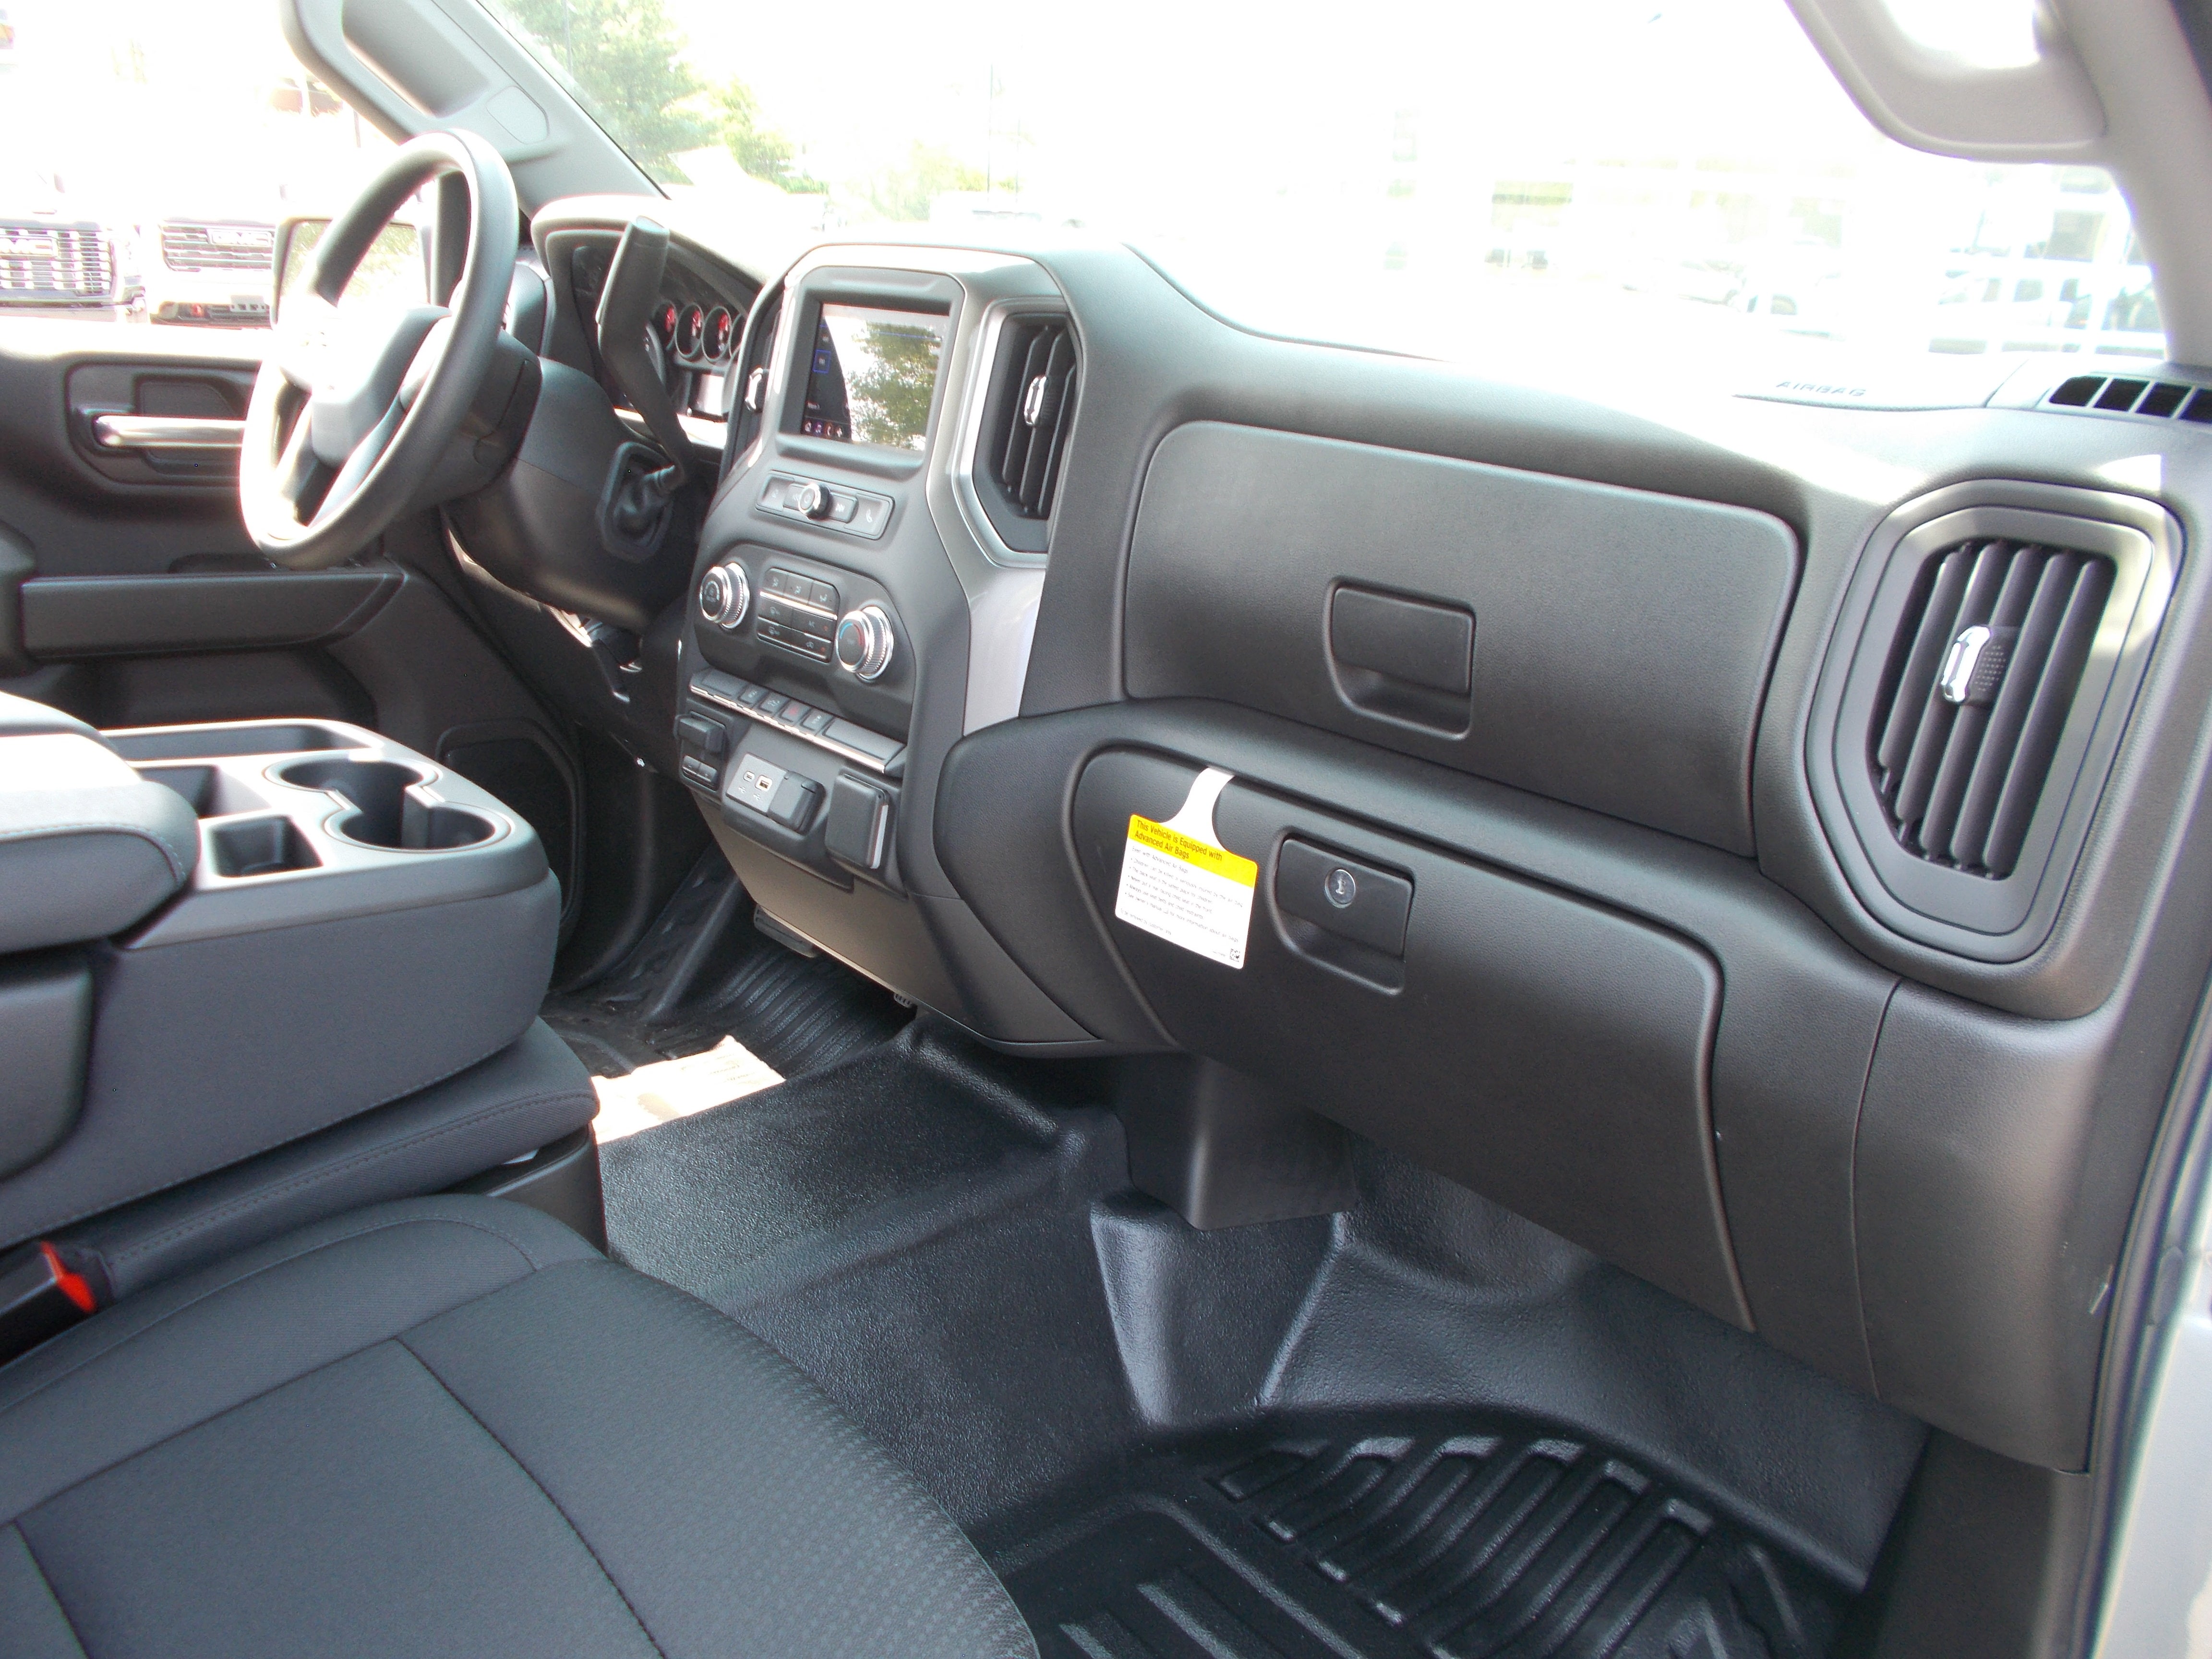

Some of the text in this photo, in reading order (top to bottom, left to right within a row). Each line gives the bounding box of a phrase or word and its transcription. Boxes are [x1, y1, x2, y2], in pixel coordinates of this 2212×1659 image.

[0, 237, 53, 254] MC
[212, 230, 269, 245] GMC
[1775, 382, 1866, 397] AIRBAG
[1135, 830, 1190, 859] Advanced Air Bags
[1137, 820, 1222, 861] This Vehicle is Equipped with
